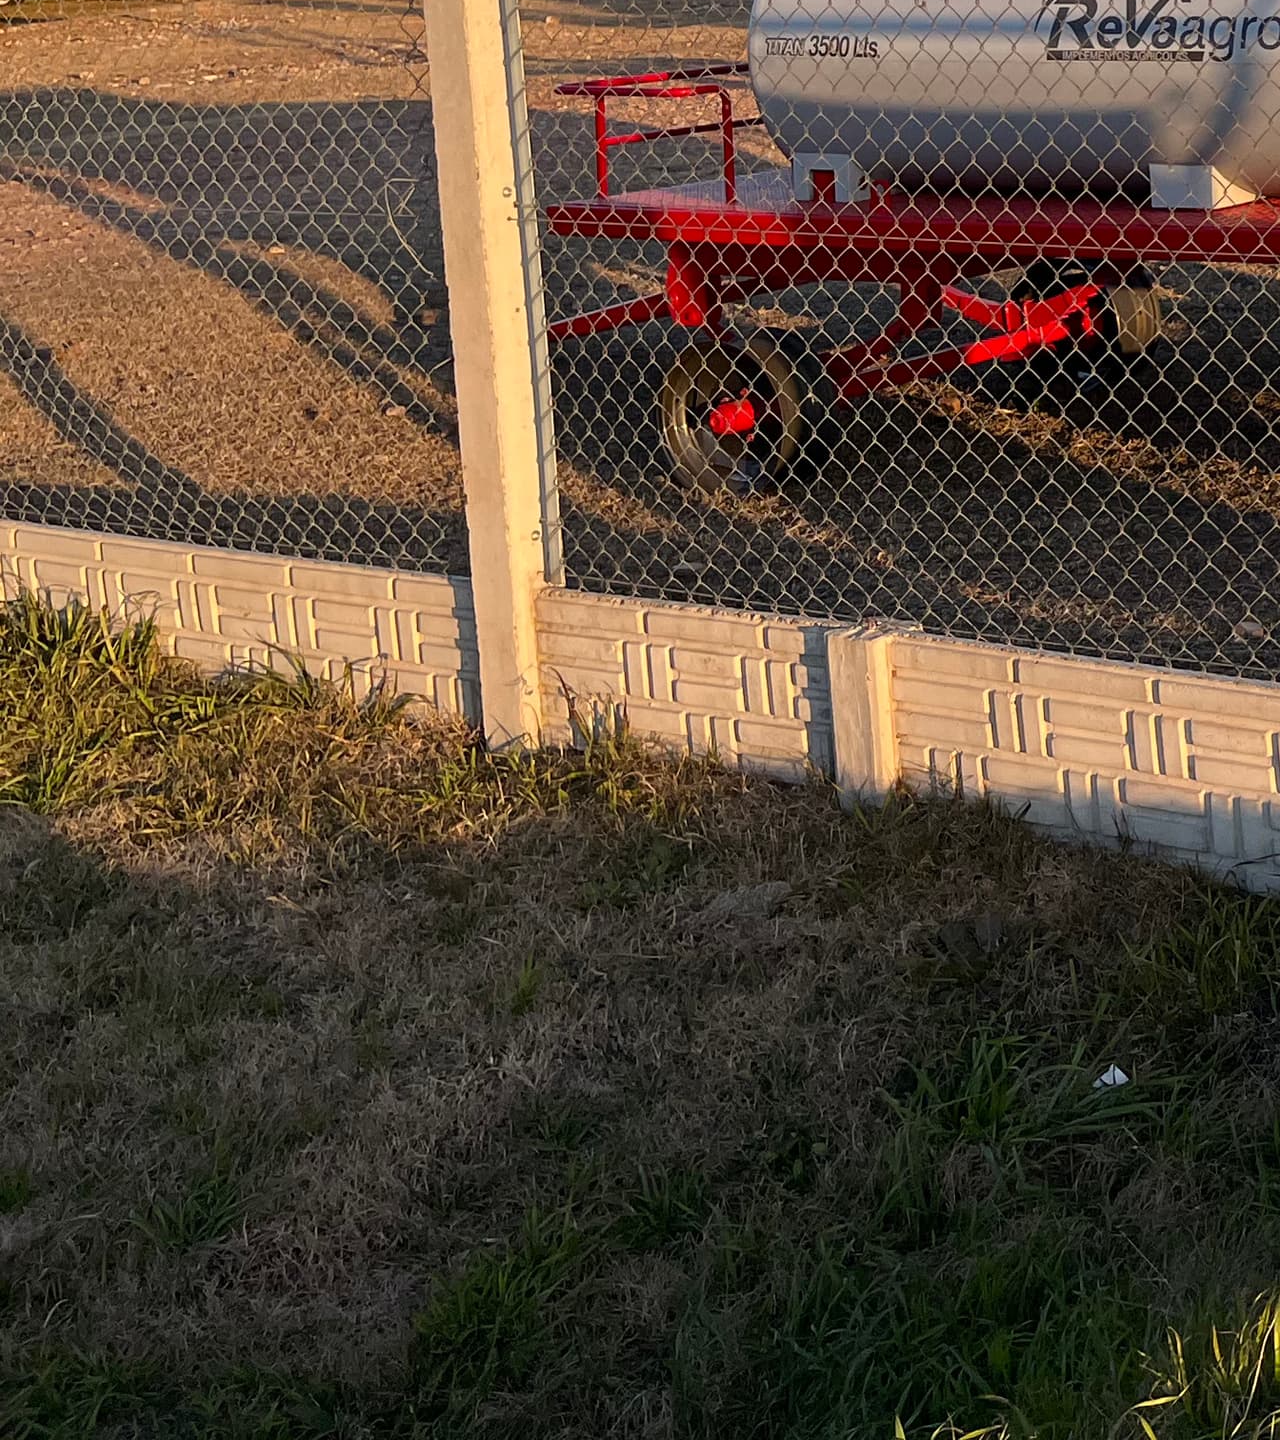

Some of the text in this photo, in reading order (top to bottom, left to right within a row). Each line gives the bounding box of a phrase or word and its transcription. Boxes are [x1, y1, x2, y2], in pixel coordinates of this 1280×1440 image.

[765, 38, 805, 56] TITAN
[809, 35, 850, 57] 3500
[1062, 50, 1131, 61] IMPLEMENTOS
